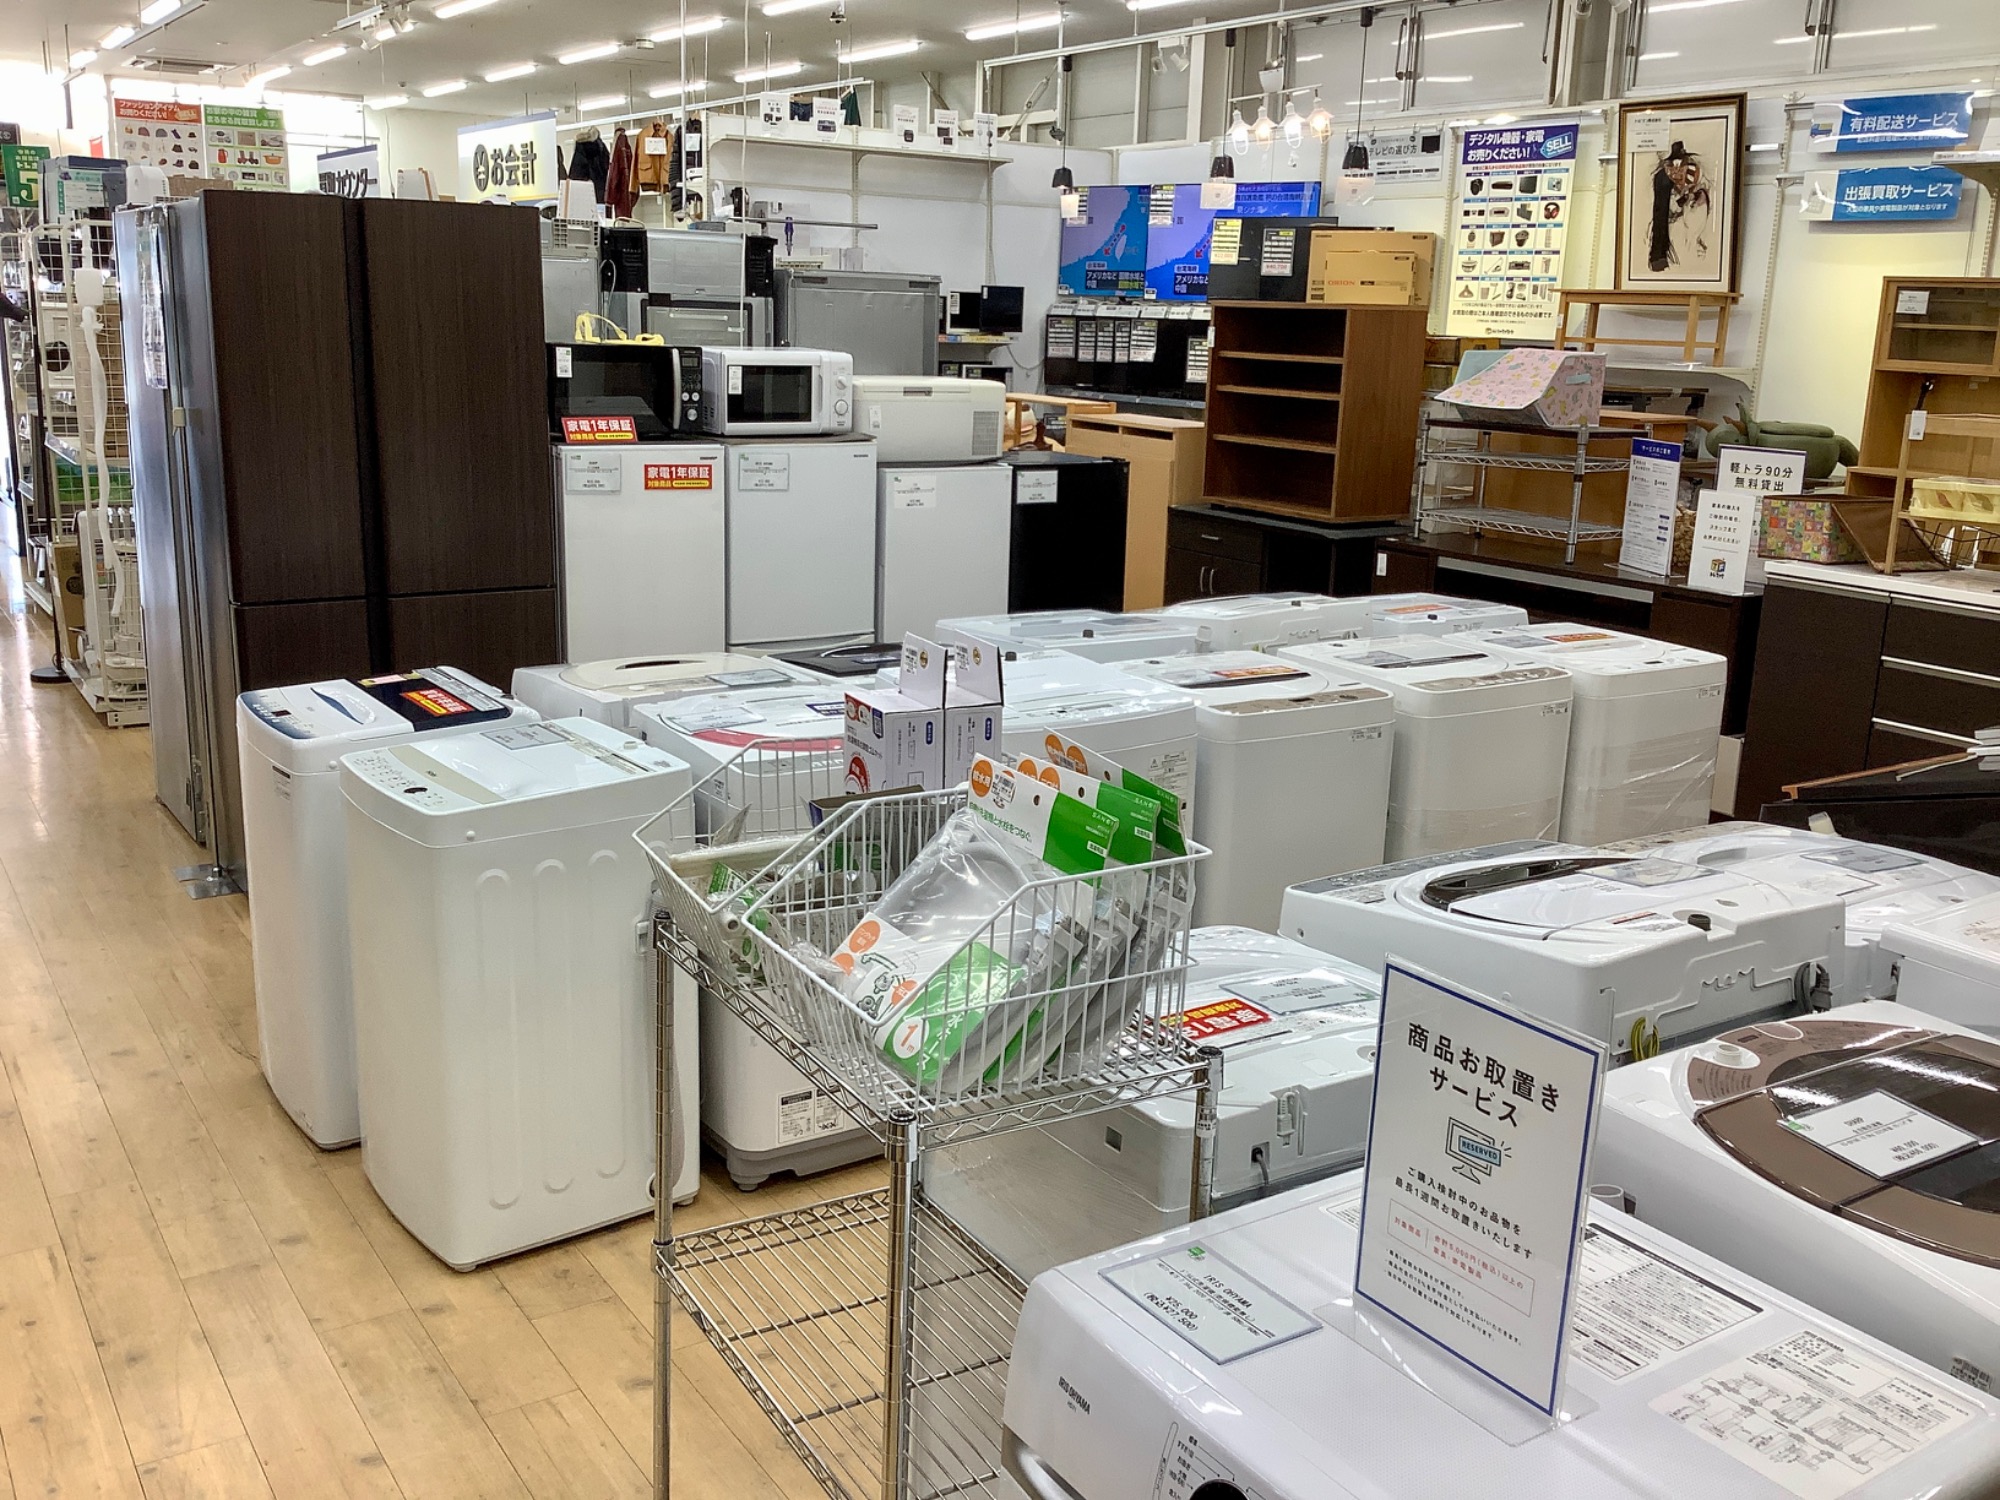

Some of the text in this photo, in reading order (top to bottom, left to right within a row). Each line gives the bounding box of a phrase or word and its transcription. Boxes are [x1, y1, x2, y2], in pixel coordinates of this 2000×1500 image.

[1850, 112, 1958, 132] 有料配送サービス
[1468, 129, 1545, 146] デジタル機器・家電
[1546, 135, 1572, 152] SELL
[1369, 144, 1417, 156] テレビの選び方
[1467, 148, 1530, 162] お売りください!
[491, 141, 537, 186] お会計
[1844, 182, 1953, 201] 出張買取サービス
[567, 419, 632, 432] 家電1年保証
[648, 466, 709, 479] 家電1年保証
[1730, 462, 1793, 478] 軽トラ90分
[1734, 476, 1784, 492] 無料貸出
[1408, 1022, 1560, 1113] 商品お取置き
[1430, 1067, 1518, 1128] サービス
[1461, 1140, 1498, 1161] RESERVED
[1408, 1167, 1521, 1236] ご購入検討中のお品物を
[1394, 1216, 1421, 1238] 対象商品
[1395, 1176, 1532, 1260] 最長1週間お取置きいたします
[1203, 1274, 1253, 1309] IRIS OHYAMA
[1059, 1376, 1091, 1415] IRIS OHYAMA
